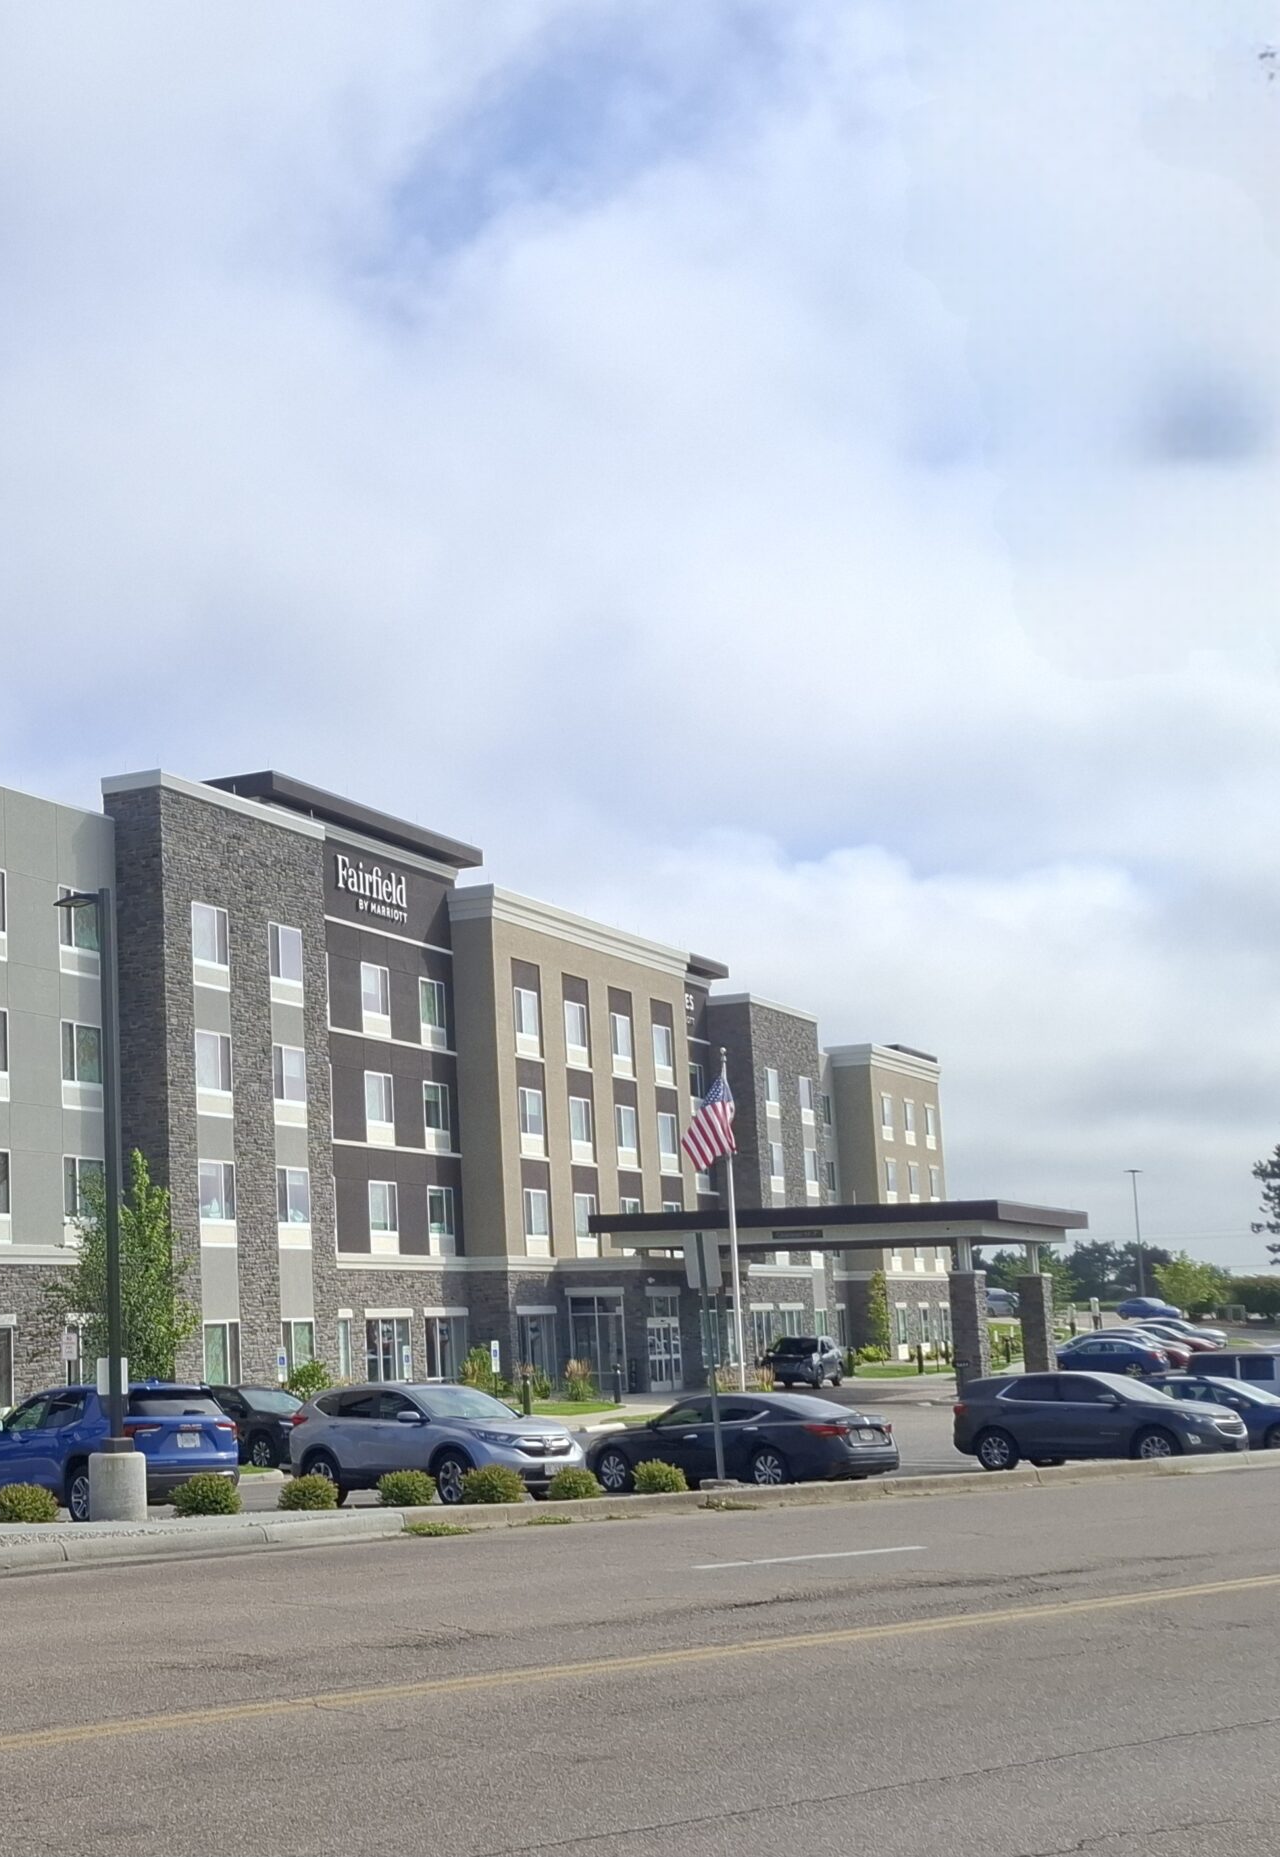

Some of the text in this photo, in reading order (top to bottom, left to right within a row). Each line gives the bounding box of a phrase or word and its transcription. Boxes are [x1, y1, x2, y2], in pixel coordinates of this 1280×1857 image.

[336, 854, 407, 908] Fairfield
[359, 898, 408, 923] BY MARRIOTT
